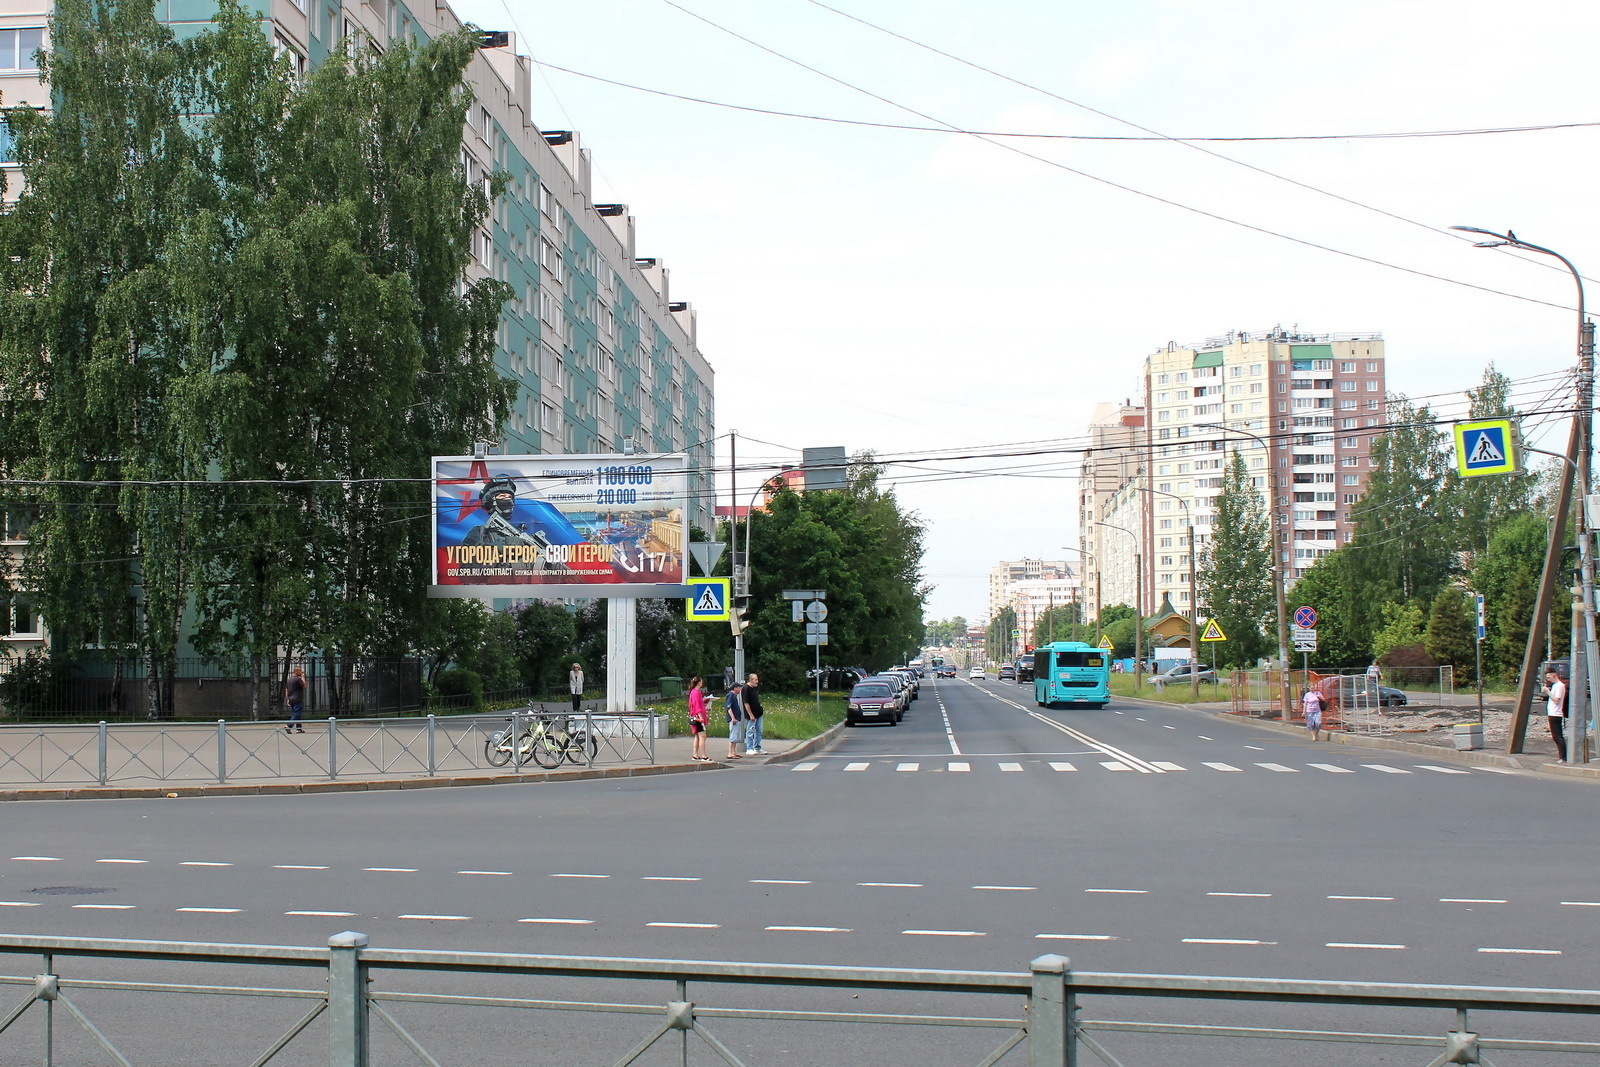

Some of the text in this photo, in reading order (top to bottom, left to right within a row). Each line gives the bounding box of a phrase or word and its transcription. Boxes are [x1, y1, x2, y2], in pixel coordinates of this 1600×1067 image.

[596, 488, 636, 504] 210 000
[447, 546, 455, 564] У
[455, 545, 537, 566] ГОРОДА-ГЕРОЯ
[545, 544, 576, 563] СВОИ
[578, 544, 614, 563] ГЕРОИ
[637, 552, 667, 573] 117
[447, 568, 513, 577] GOV.SPB.RU/CONTRACT
